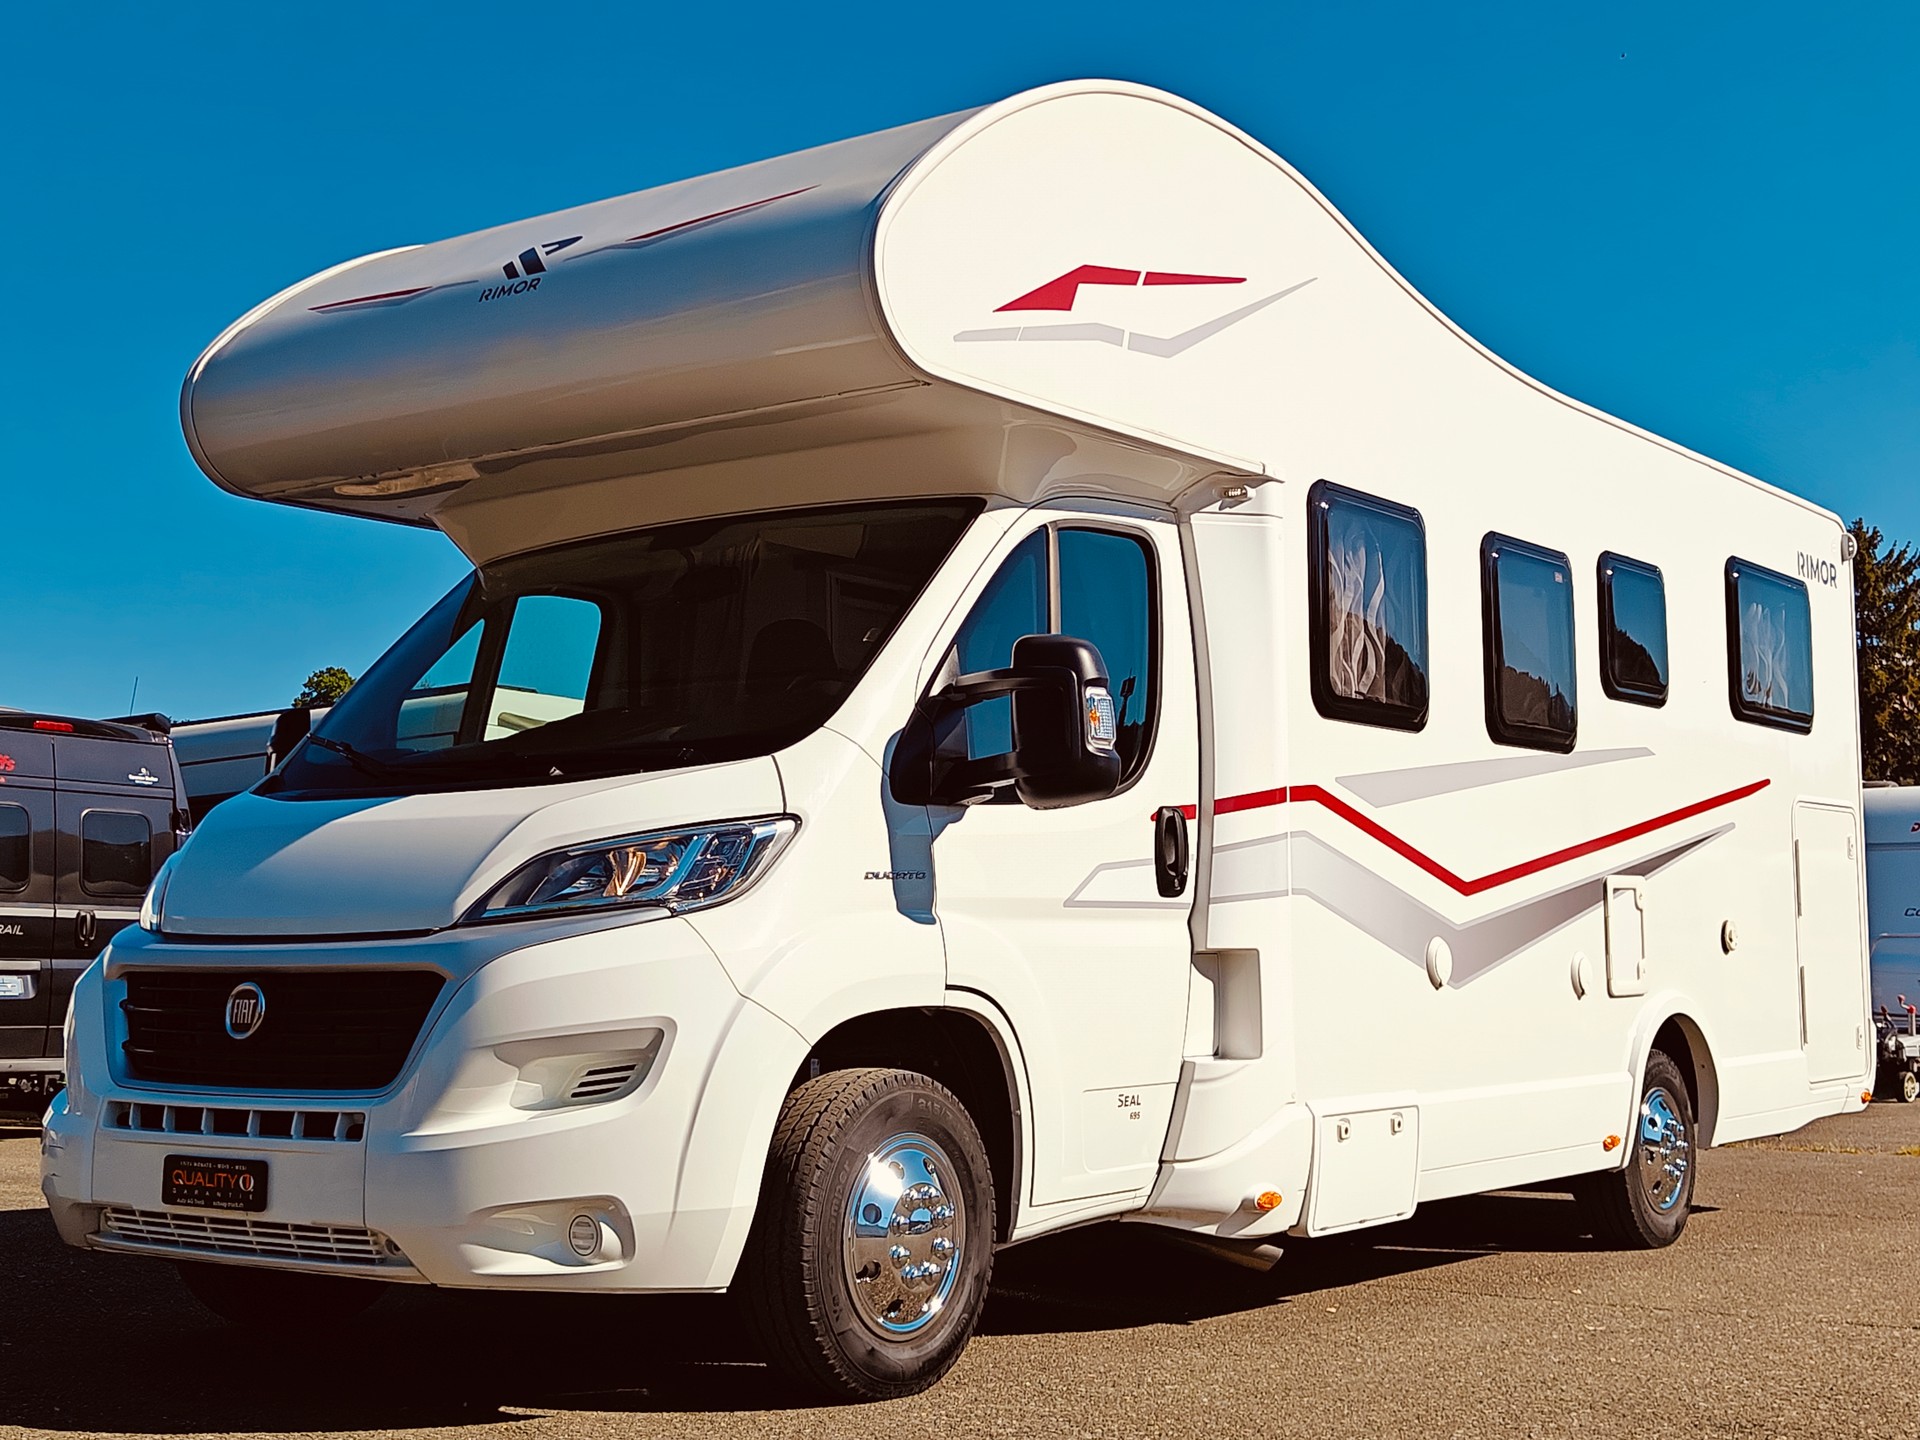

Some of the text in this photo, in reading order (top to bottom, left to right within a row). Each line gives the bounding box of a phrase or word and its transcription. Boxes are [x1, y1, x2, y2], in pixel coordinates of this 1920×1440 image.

[478, 277, 542, 302] RIMOR
[1797, 551, 1838, 589] RIMOR
[864, 871, 927, 880] DUCATO
[232, 999, 256, 1024] FIAT
[1129, 1111, 1141, 1120] 695
[172, 1169, 238, 1189] QUALITY
[172, 1187, 254, 1200] GARANTIE
